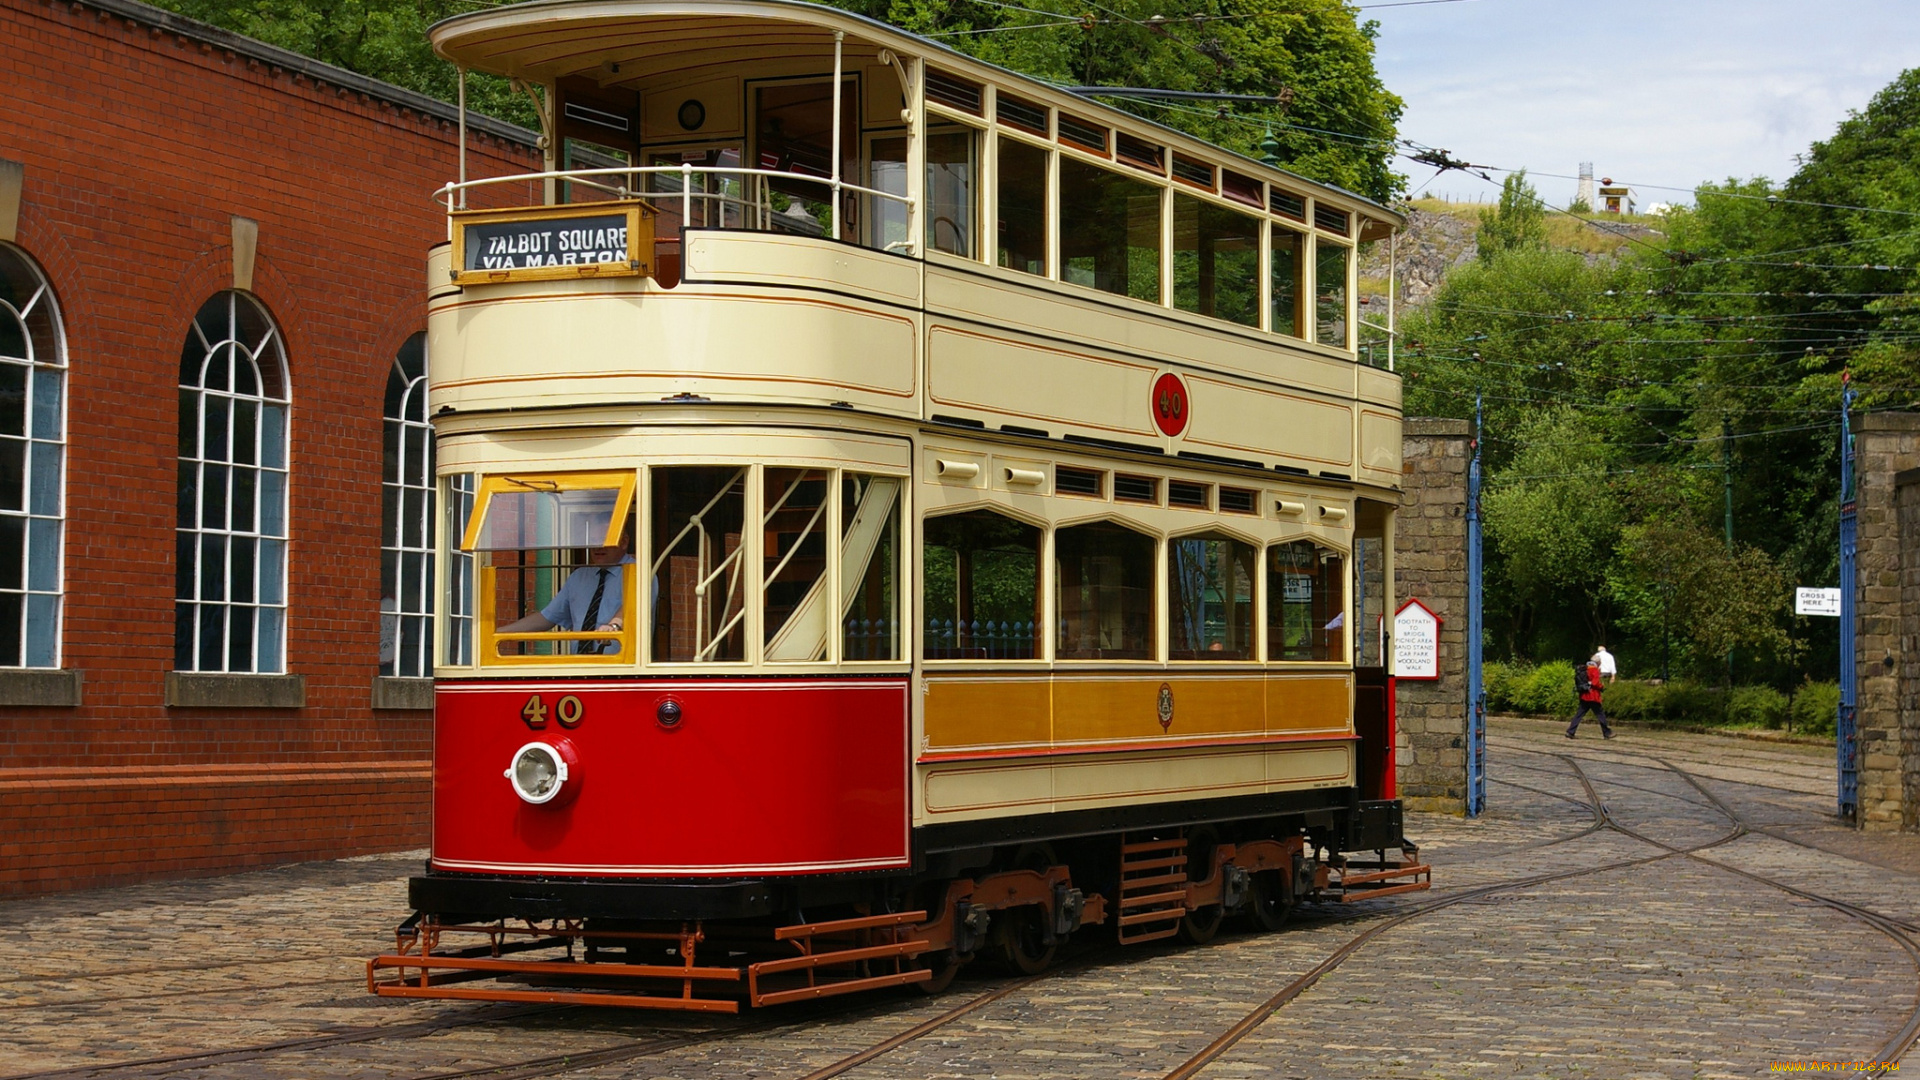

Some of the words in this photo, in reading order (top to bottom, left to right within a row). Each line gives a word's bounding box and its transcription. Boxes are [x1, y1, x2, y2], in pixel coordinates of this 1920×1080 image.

[488, 231, 552, 255] TALBOT
[559, 227, 627, 251] SQUARE
[482, 255, 515, 269] VIA
[525, 250, 628, 269] MARTON
[1160, 390, 1181, 416] 40
[521, 694, 583, 728] 40
